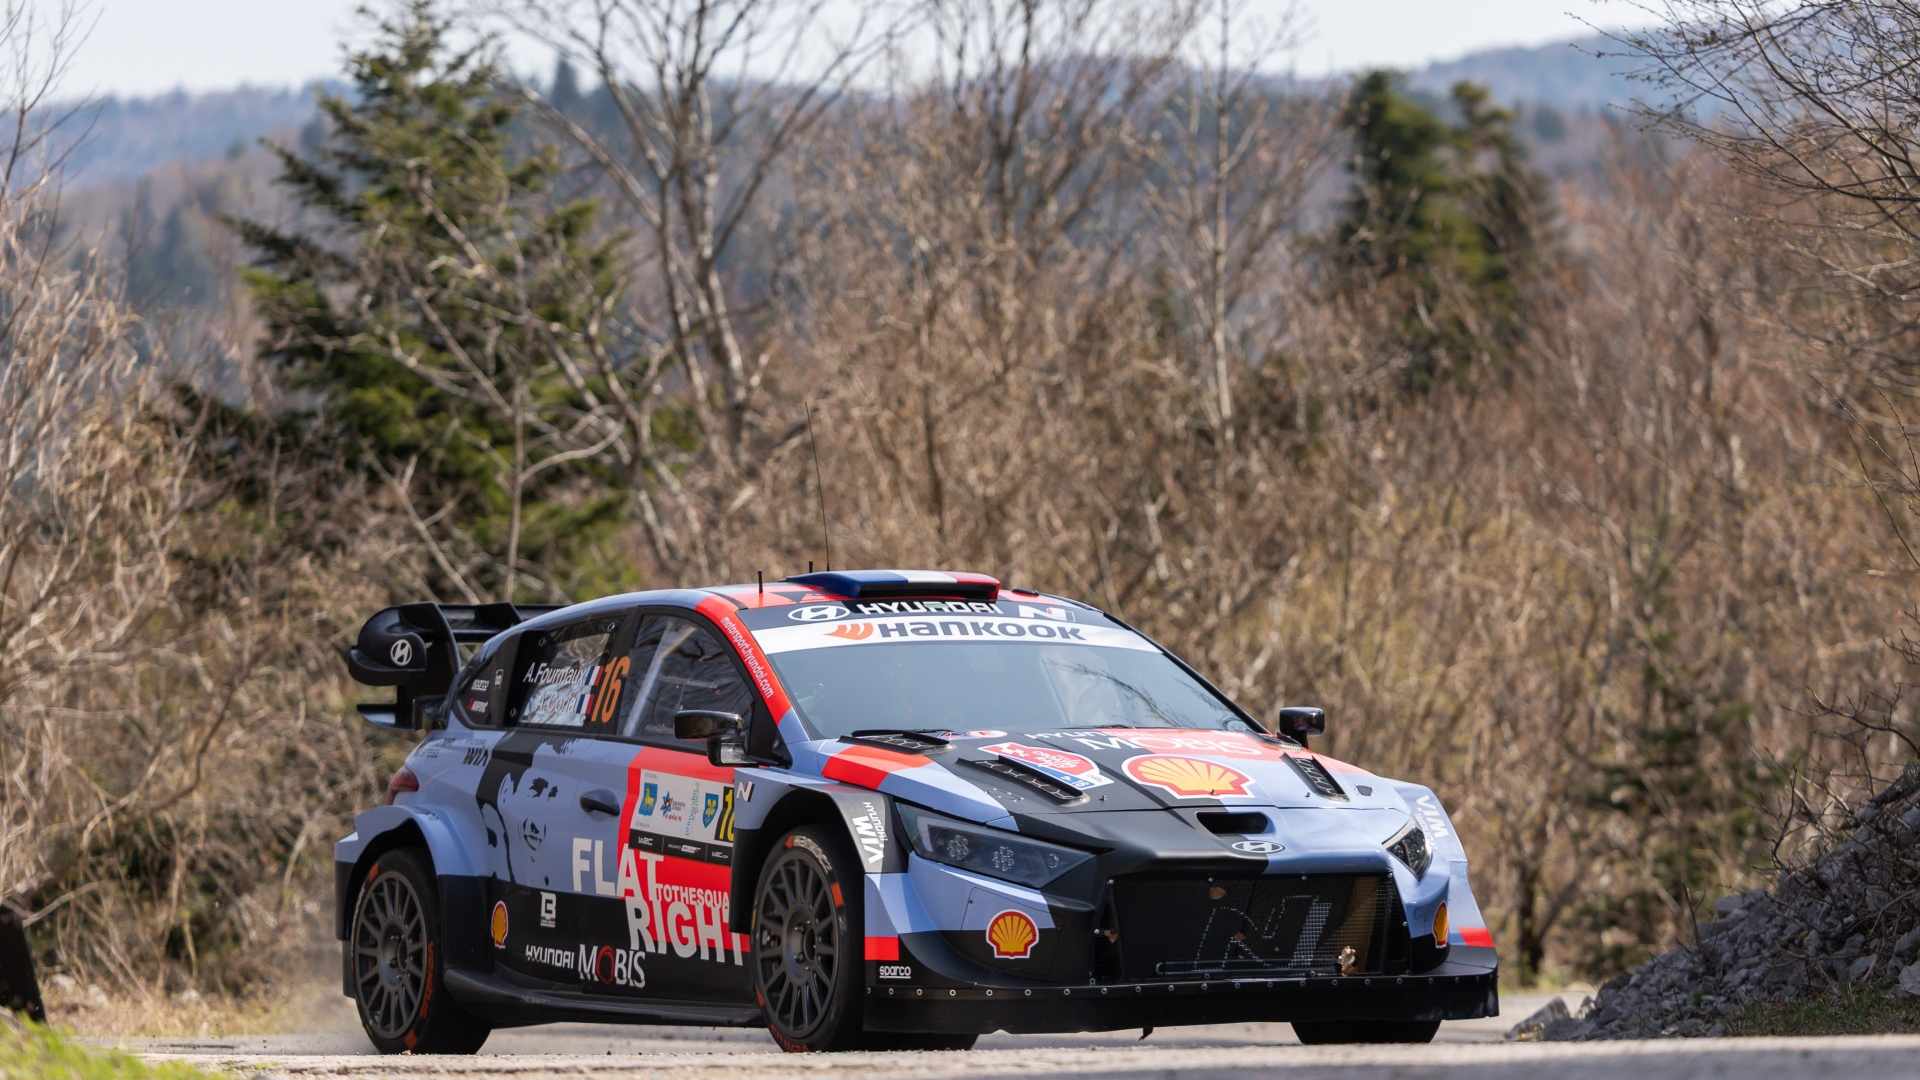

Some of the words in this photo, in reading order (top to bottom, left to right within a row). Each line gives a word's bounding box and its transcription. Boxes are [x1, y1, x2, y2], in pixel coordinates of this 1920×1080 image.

[856, 602, 1003, 615] HYUNDAI
[523, 662, 586, 684] A.Fourmaux
[720, 616, 775, 699] motorsport.hyundai.com
[591, 655, 631, 723] 16
[1073, 737, 1263, 755] MOBIS
[863, 802, 889, 841] HYUNDAI
[1416, 795, 1449, 838] WIA
[852, 816, 884, 864] WIA
[573, 837, 664, 901] FLAT
[525, 944, 575, 969] HYUNDAI
[578, 944, 646, 988] MOBIS
[879, 965, 912, 979] sparco
